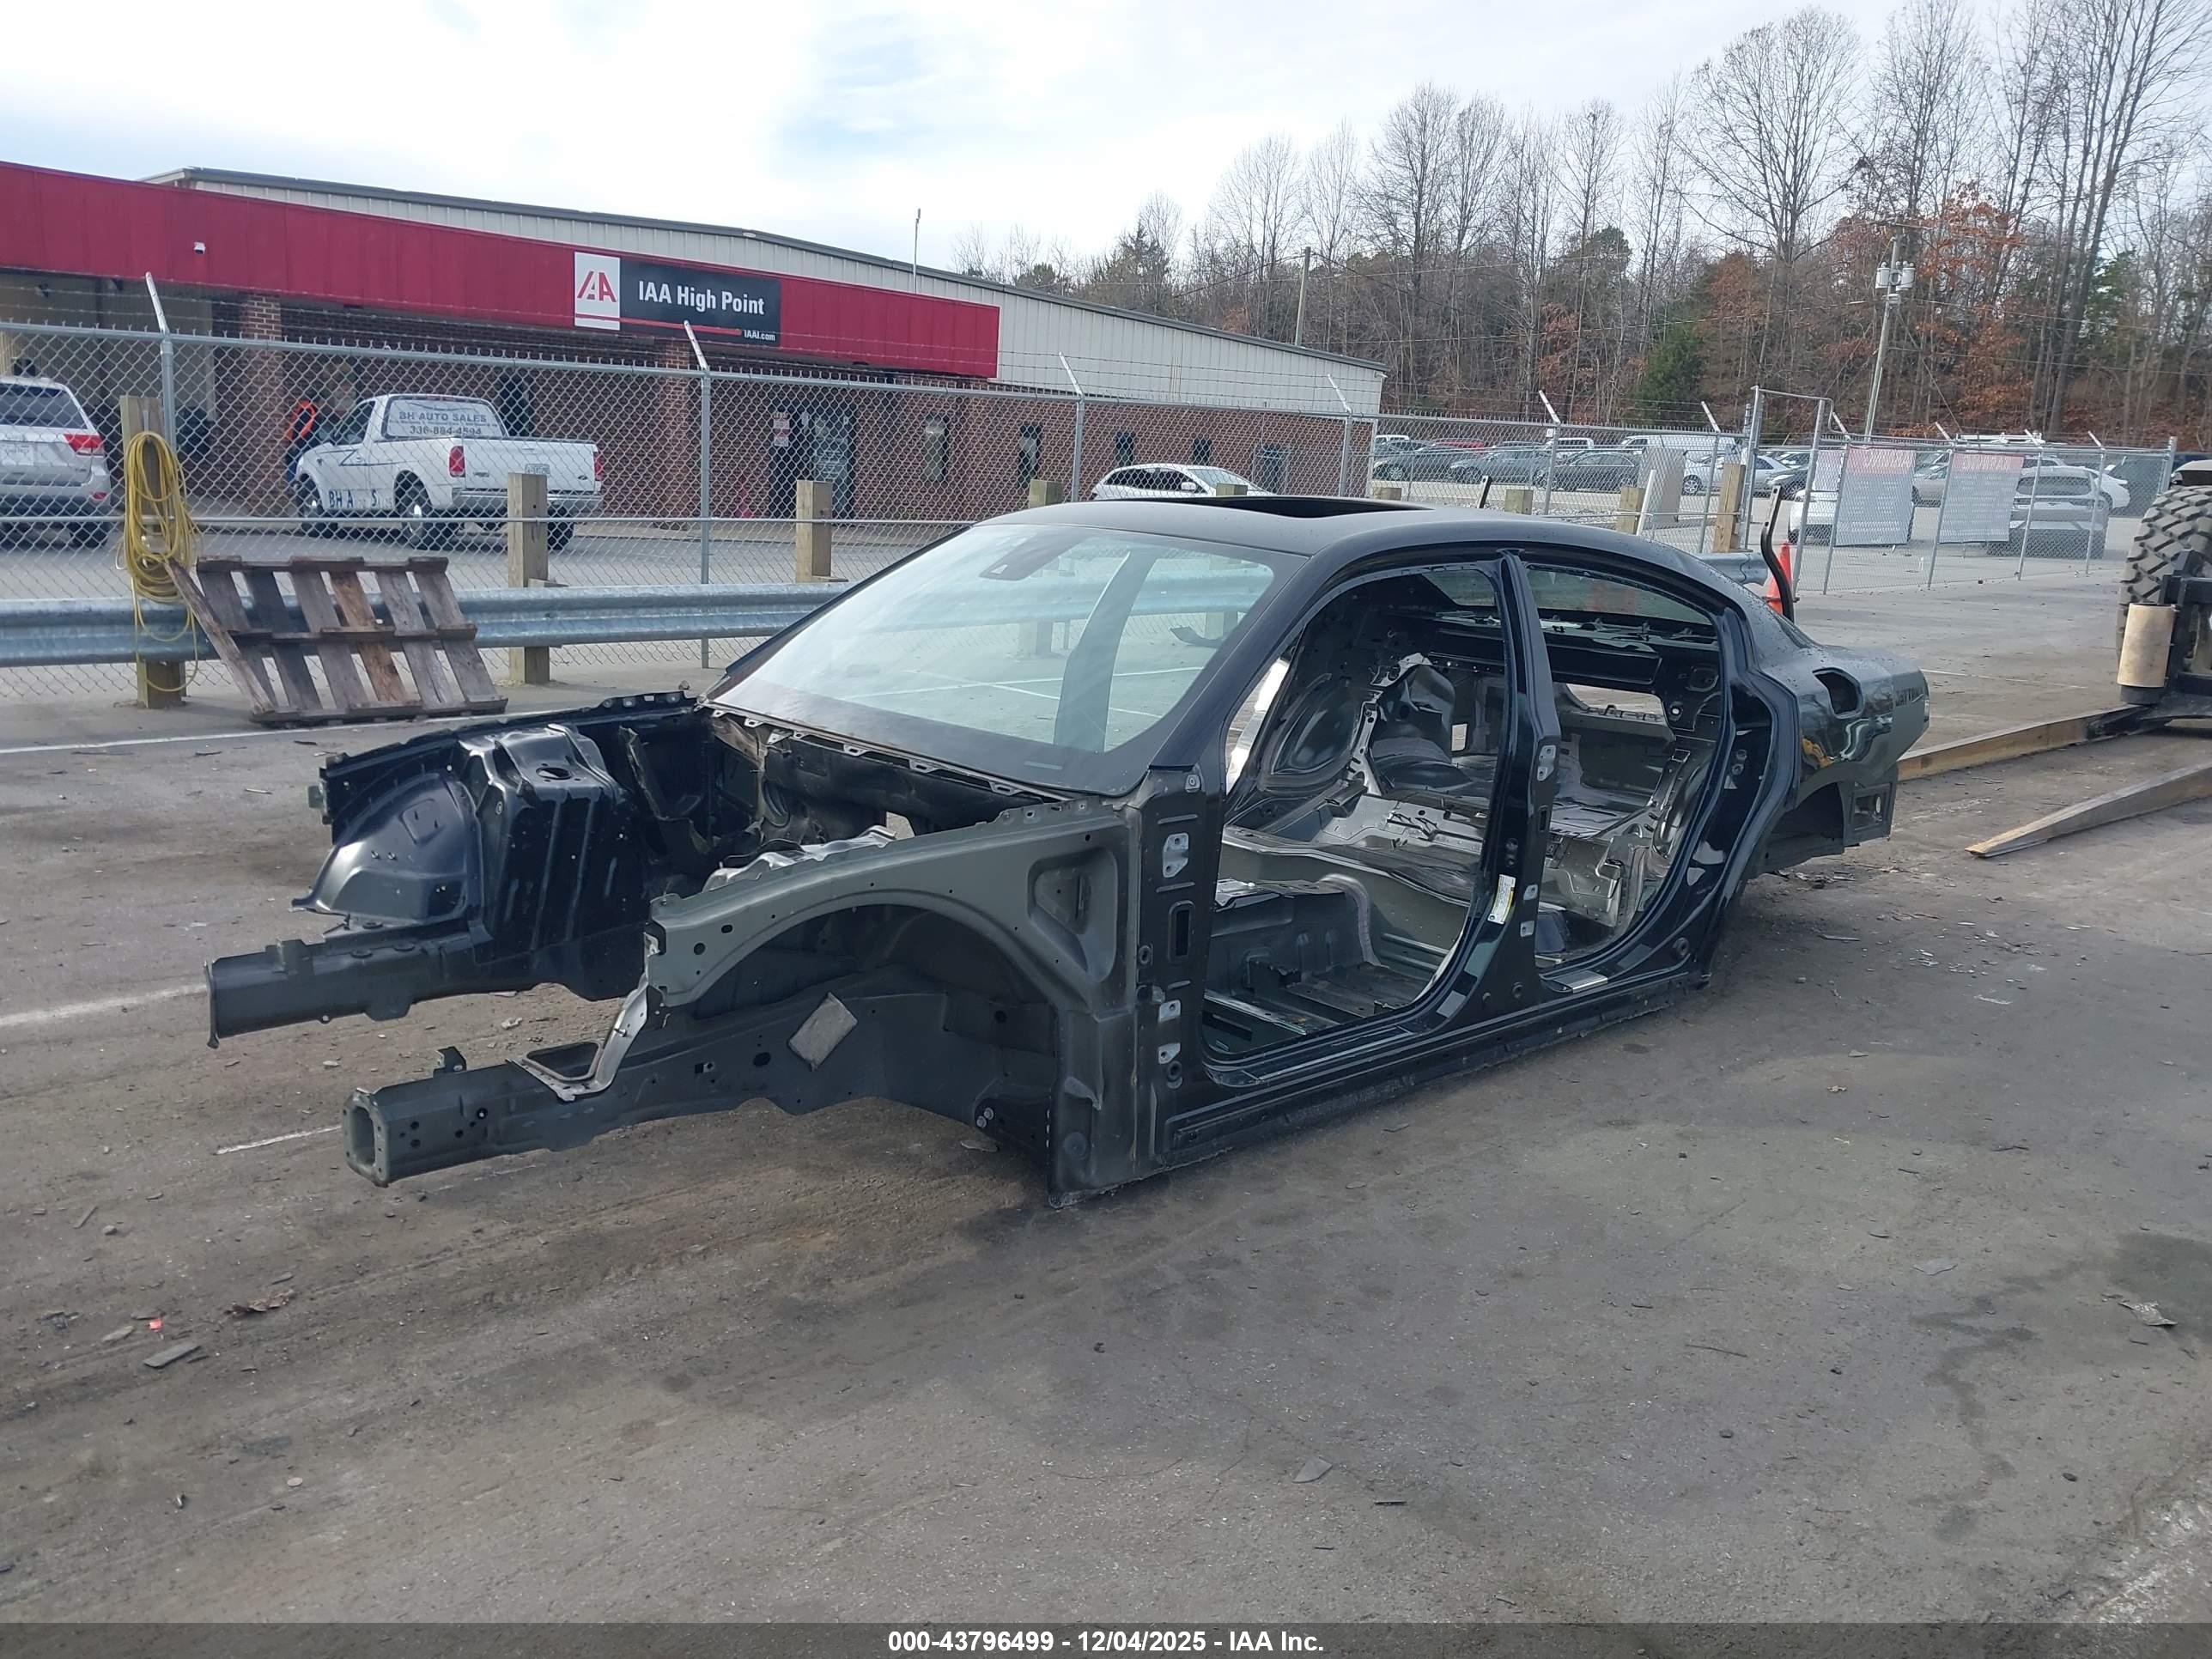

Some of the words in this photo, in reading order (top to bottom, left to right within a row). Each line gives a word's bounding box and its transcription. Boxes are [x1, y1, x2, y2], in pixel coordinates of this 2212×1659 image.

[639, 280, 672, 304] IAA
[678, 285, 716, 312] High
[721, 291, 765, 315] Point
[418, 411, 449, 422] AUTO
[453, 413, 487, 423] SALES
